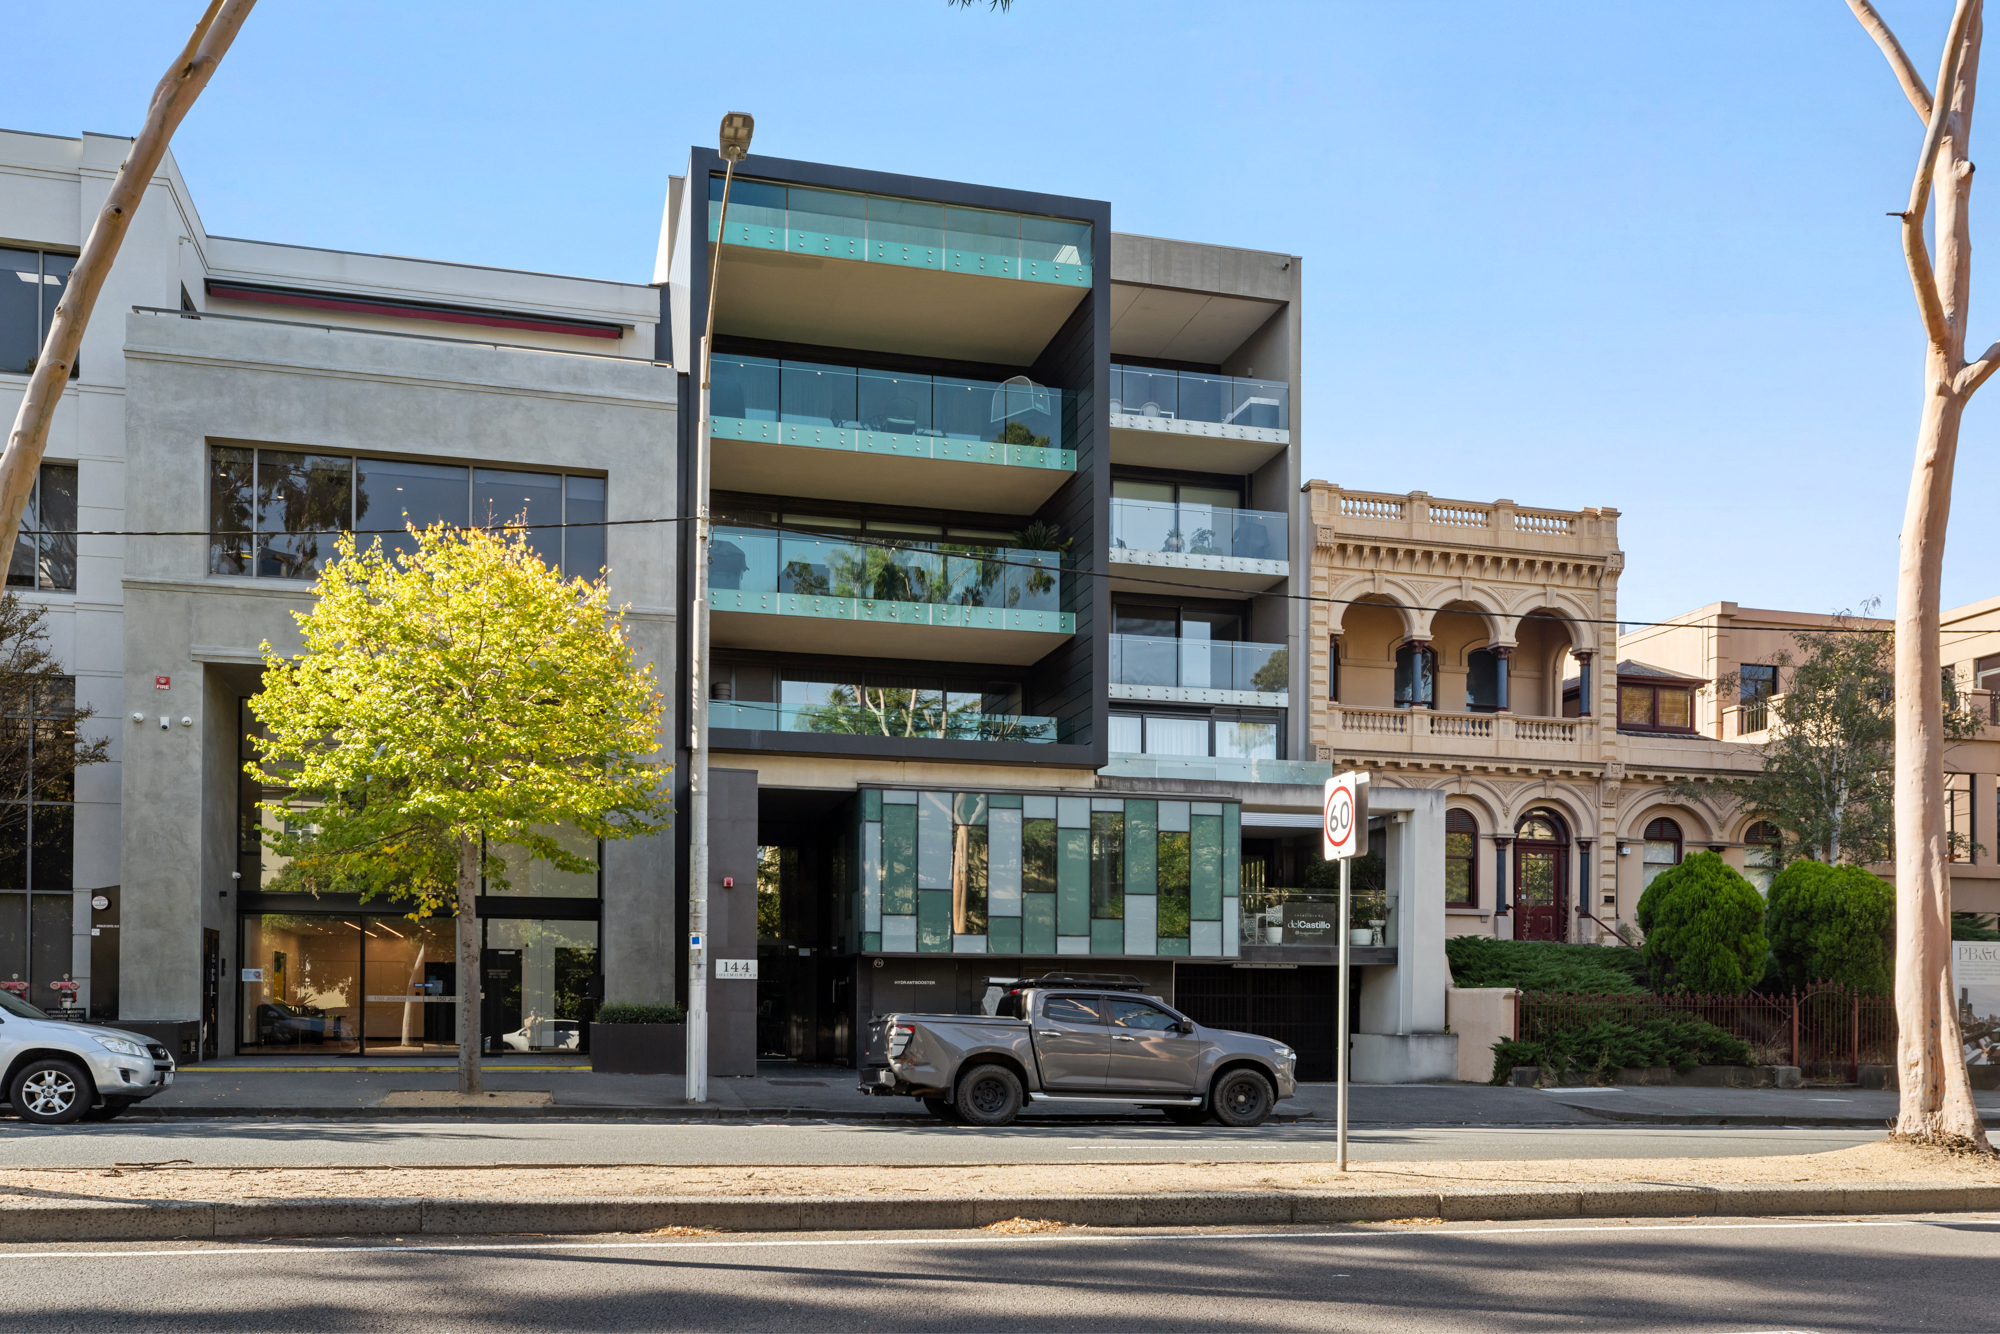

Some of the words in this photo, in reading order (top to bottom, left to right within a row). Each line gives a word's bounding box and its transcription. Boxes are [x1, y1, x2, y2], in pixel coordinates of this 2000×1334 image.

[1330, 801, 1349, 832] 60
[1287, 920, 1331, 929] delCastillo
[723, 961, 750, 973] 144
